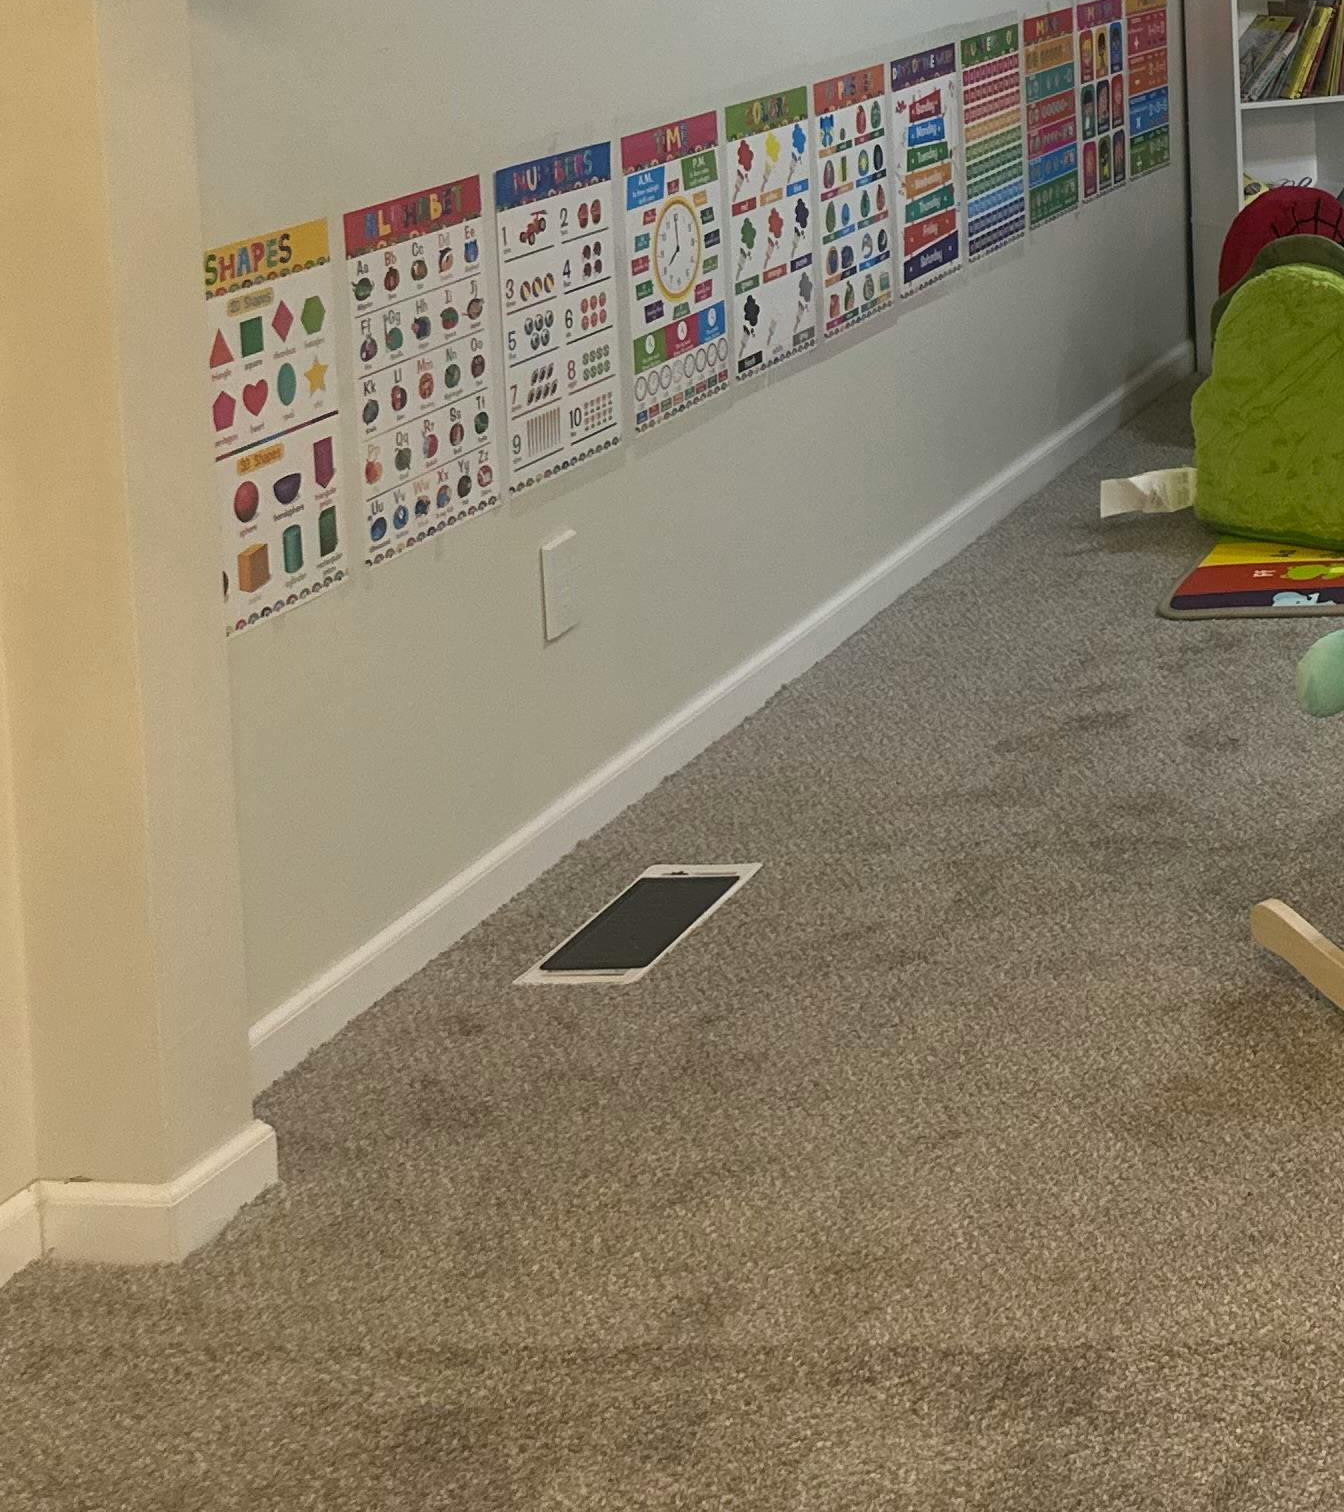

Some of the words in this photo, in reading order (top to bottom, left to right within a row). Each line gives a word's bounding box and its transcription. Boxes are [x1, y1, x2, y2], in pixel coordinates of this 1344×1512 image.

[654, 122, 689, 155] TME
[512, 150, 592, 192] NUBERS
[559, 207, 569, 228] 2
[464, 225, 476, 239] Ee
[502, 226, 508, 246] 1
[384, 251, 397, 267] Bb
[411, 241, 425, 257] Cc
[204, 233, 292, 286] SHAPES
[357, 260, 370, 275] Aa
[562, 258, 572, 279] 4
[470, 279, 479, 296] Jj
[505, 278, 515, 299] 3
[415, 299, 428, 315] Hh
[388, 309, 401, 326] Gg
[565, 309, 573, 329] 6
[470, 337, 484, 352] Oo
[508, 330, 517, 351] 5
[567, 360, 576, 380] 8
[363, 379, 377, 397] Kk
[509, 384, 518, 405] 7
[450, 407, 462, 422] Ss
[569, 407, 582, 427] 10
[396, 431, 409, 447] Qq
[512, 434, 521, 455] 9
